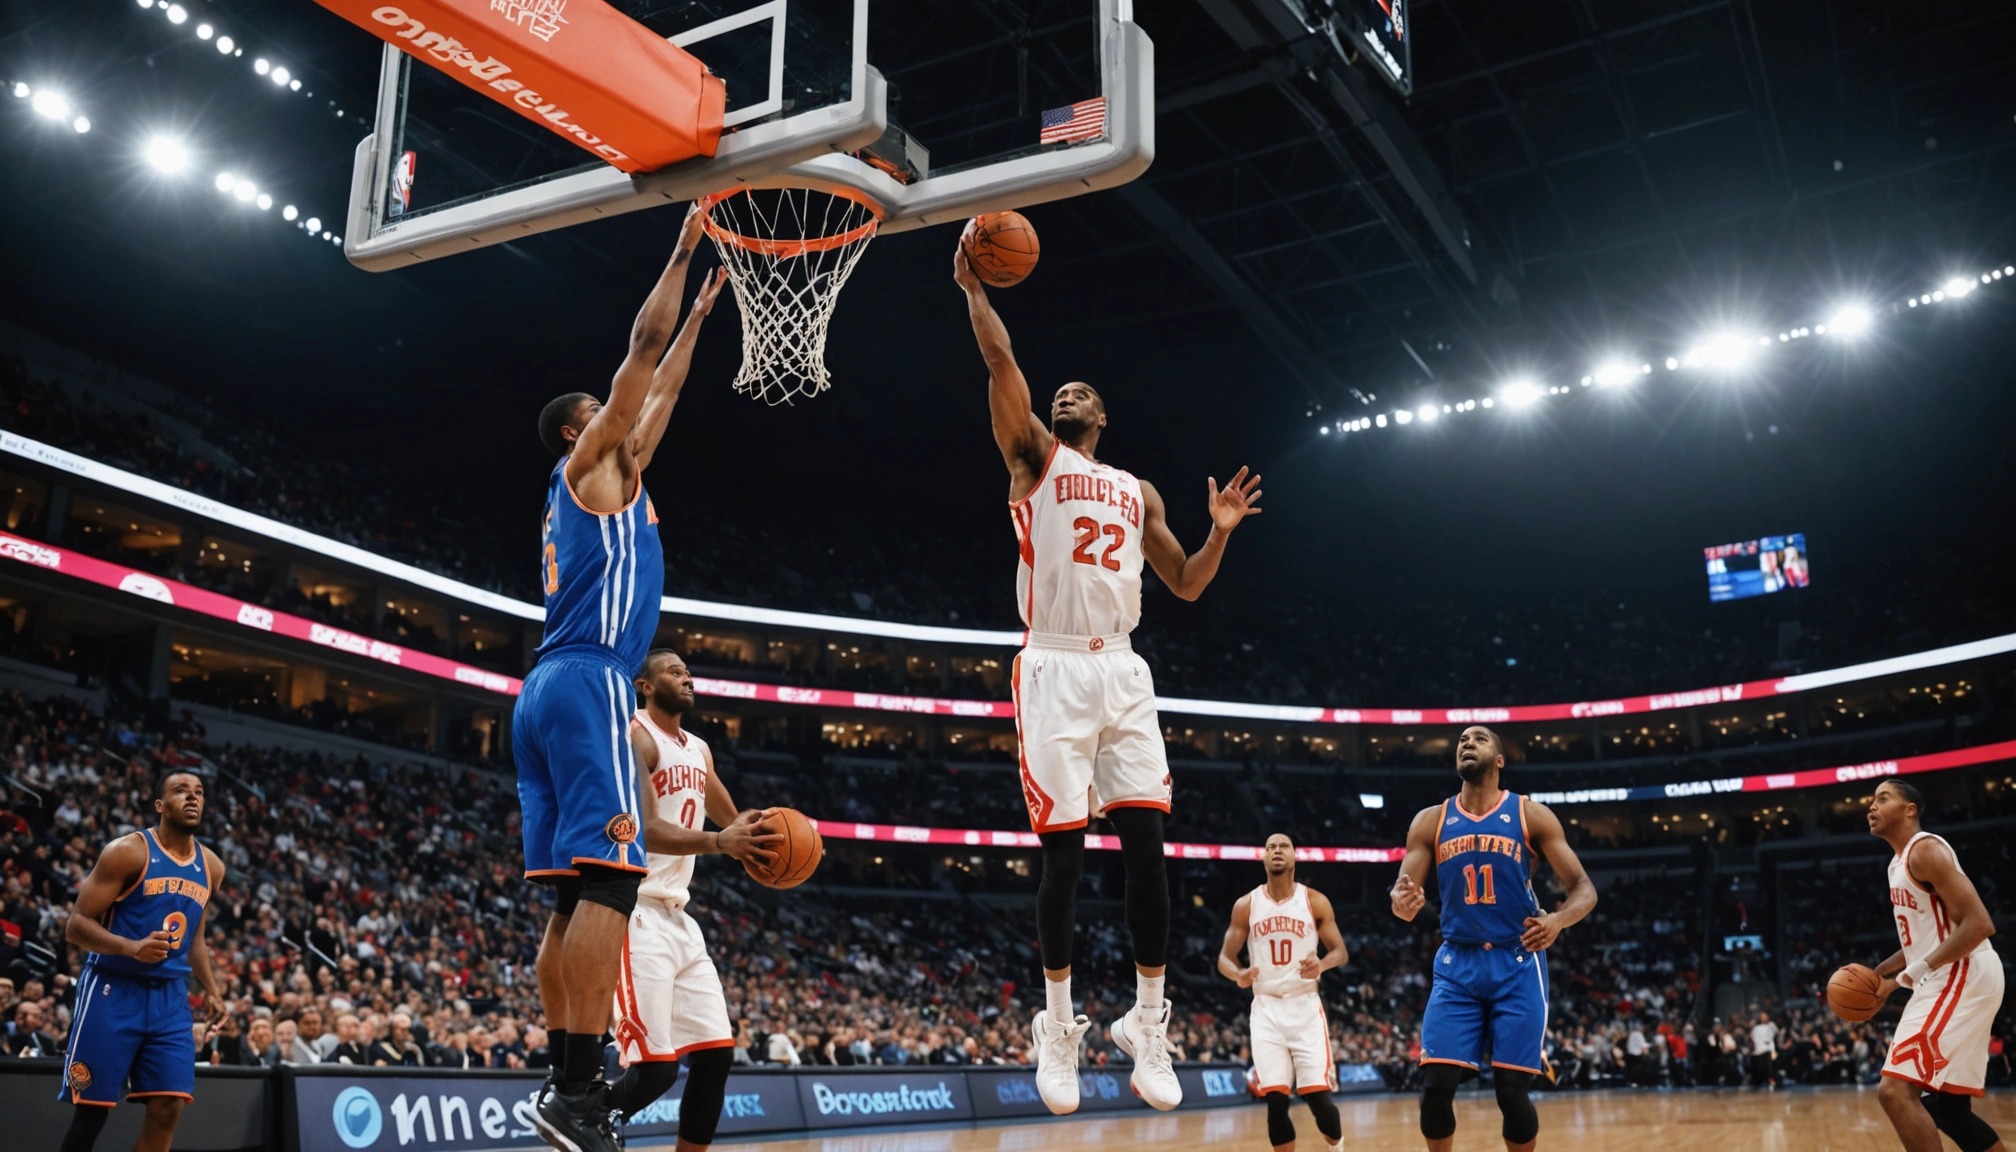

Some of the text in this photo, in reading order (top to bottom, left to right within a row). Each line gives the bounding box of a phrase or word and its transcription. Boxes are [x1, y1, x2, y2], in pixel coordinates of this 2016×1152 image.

[1073, 516, 1125, 572] 22
[1463, 864, 1496, 905] 11
[1269, 938, 1292, 966] 10
